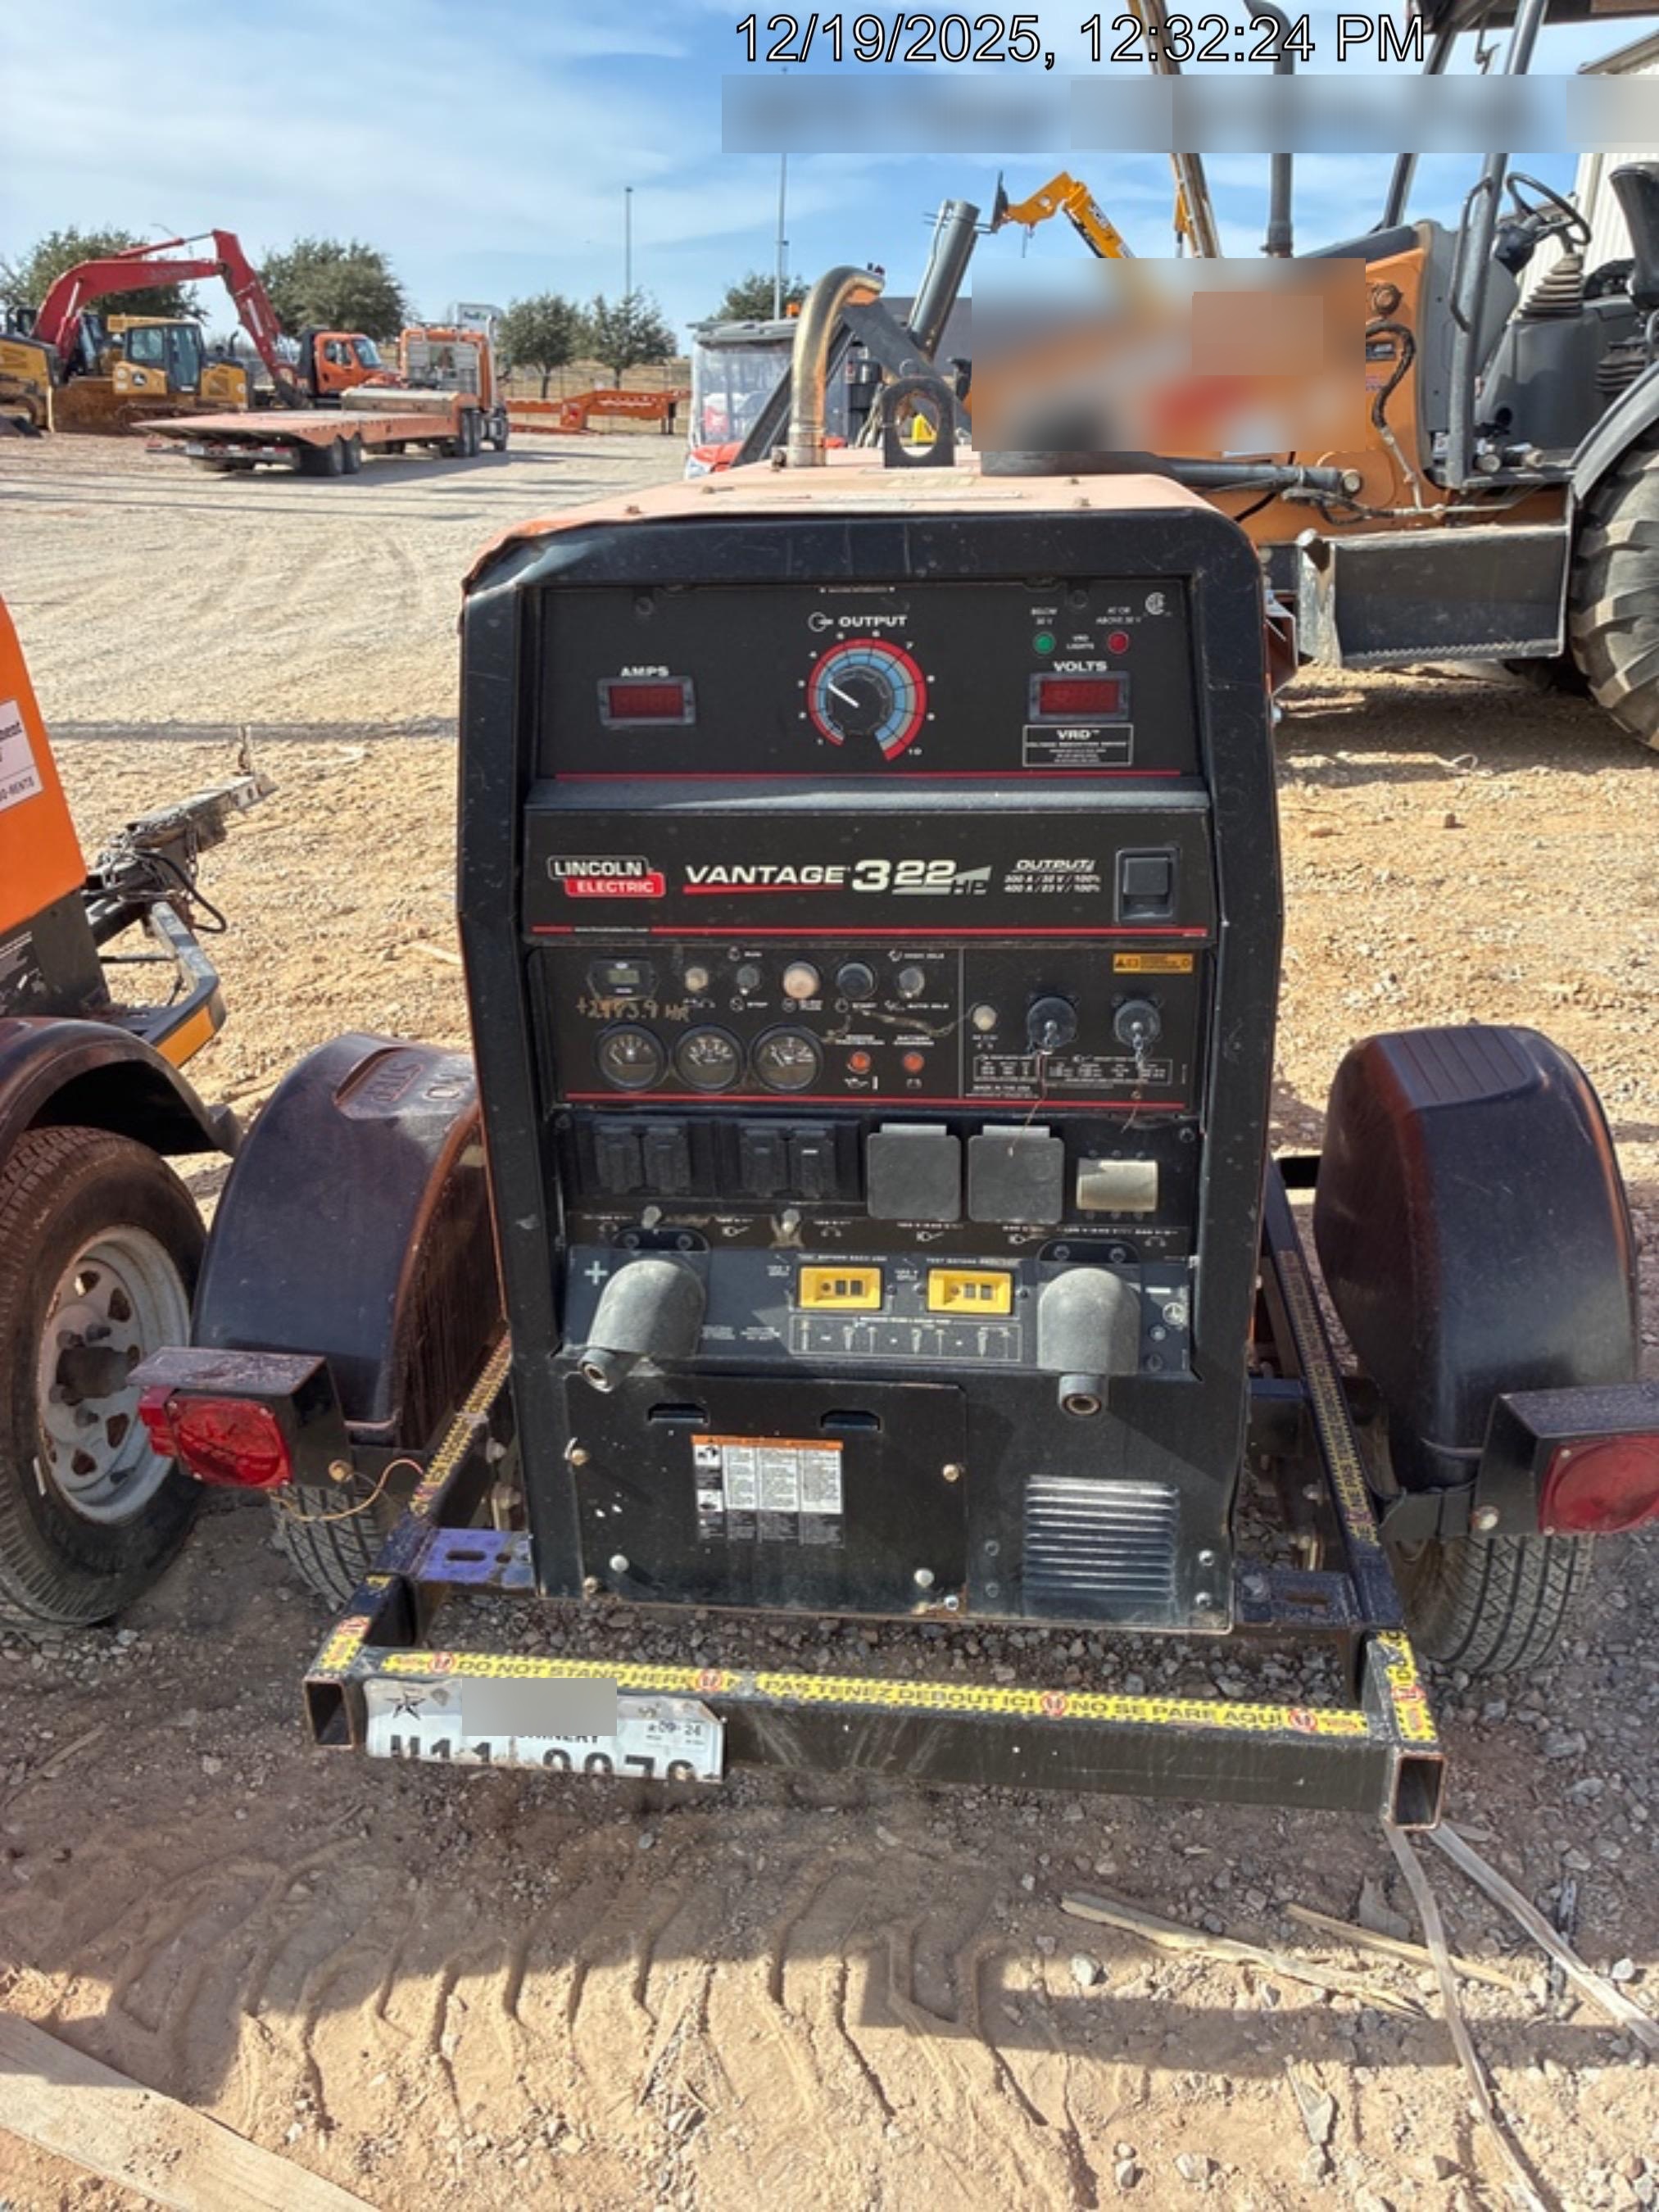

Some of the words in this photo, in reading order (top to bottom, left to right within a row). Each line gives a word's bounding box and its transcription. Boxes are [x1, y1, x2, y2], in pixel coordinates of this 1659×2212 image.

[838, 616, 907, 627] OUTPUT
[621, 666, 669, 678] AMPS
[1054, 661, 1108, 672] VOLTS
[554, 861, 642, 876] LINCOLN
[1016, 859, 1090, 871] OUTPUT
[685, 865, 845, 884] VANTAGE
[853, 859, 956, 892] 322
[576, 880, 654, 893] ELECTRIC
[457, 1661, 492, 1672] DO
[496, 1663, 546, 1675] NOT
[548, 1666, 625, 1680] STAND
[764, 1679, 811, 1693] PAS
[817, 1684, 891, 1698] TENEZ
[898, 1688, 999, 1706] DEBOUT
[1003, 1695, 1035, 1708] ICI
[1070, 1699, 1108, 1713] NO
[1115, 1702, 1145, 1716] SE
[1152, 1706, 1217, 1720] PARE
[1223, 1711, 1284, 1726] AQUI
